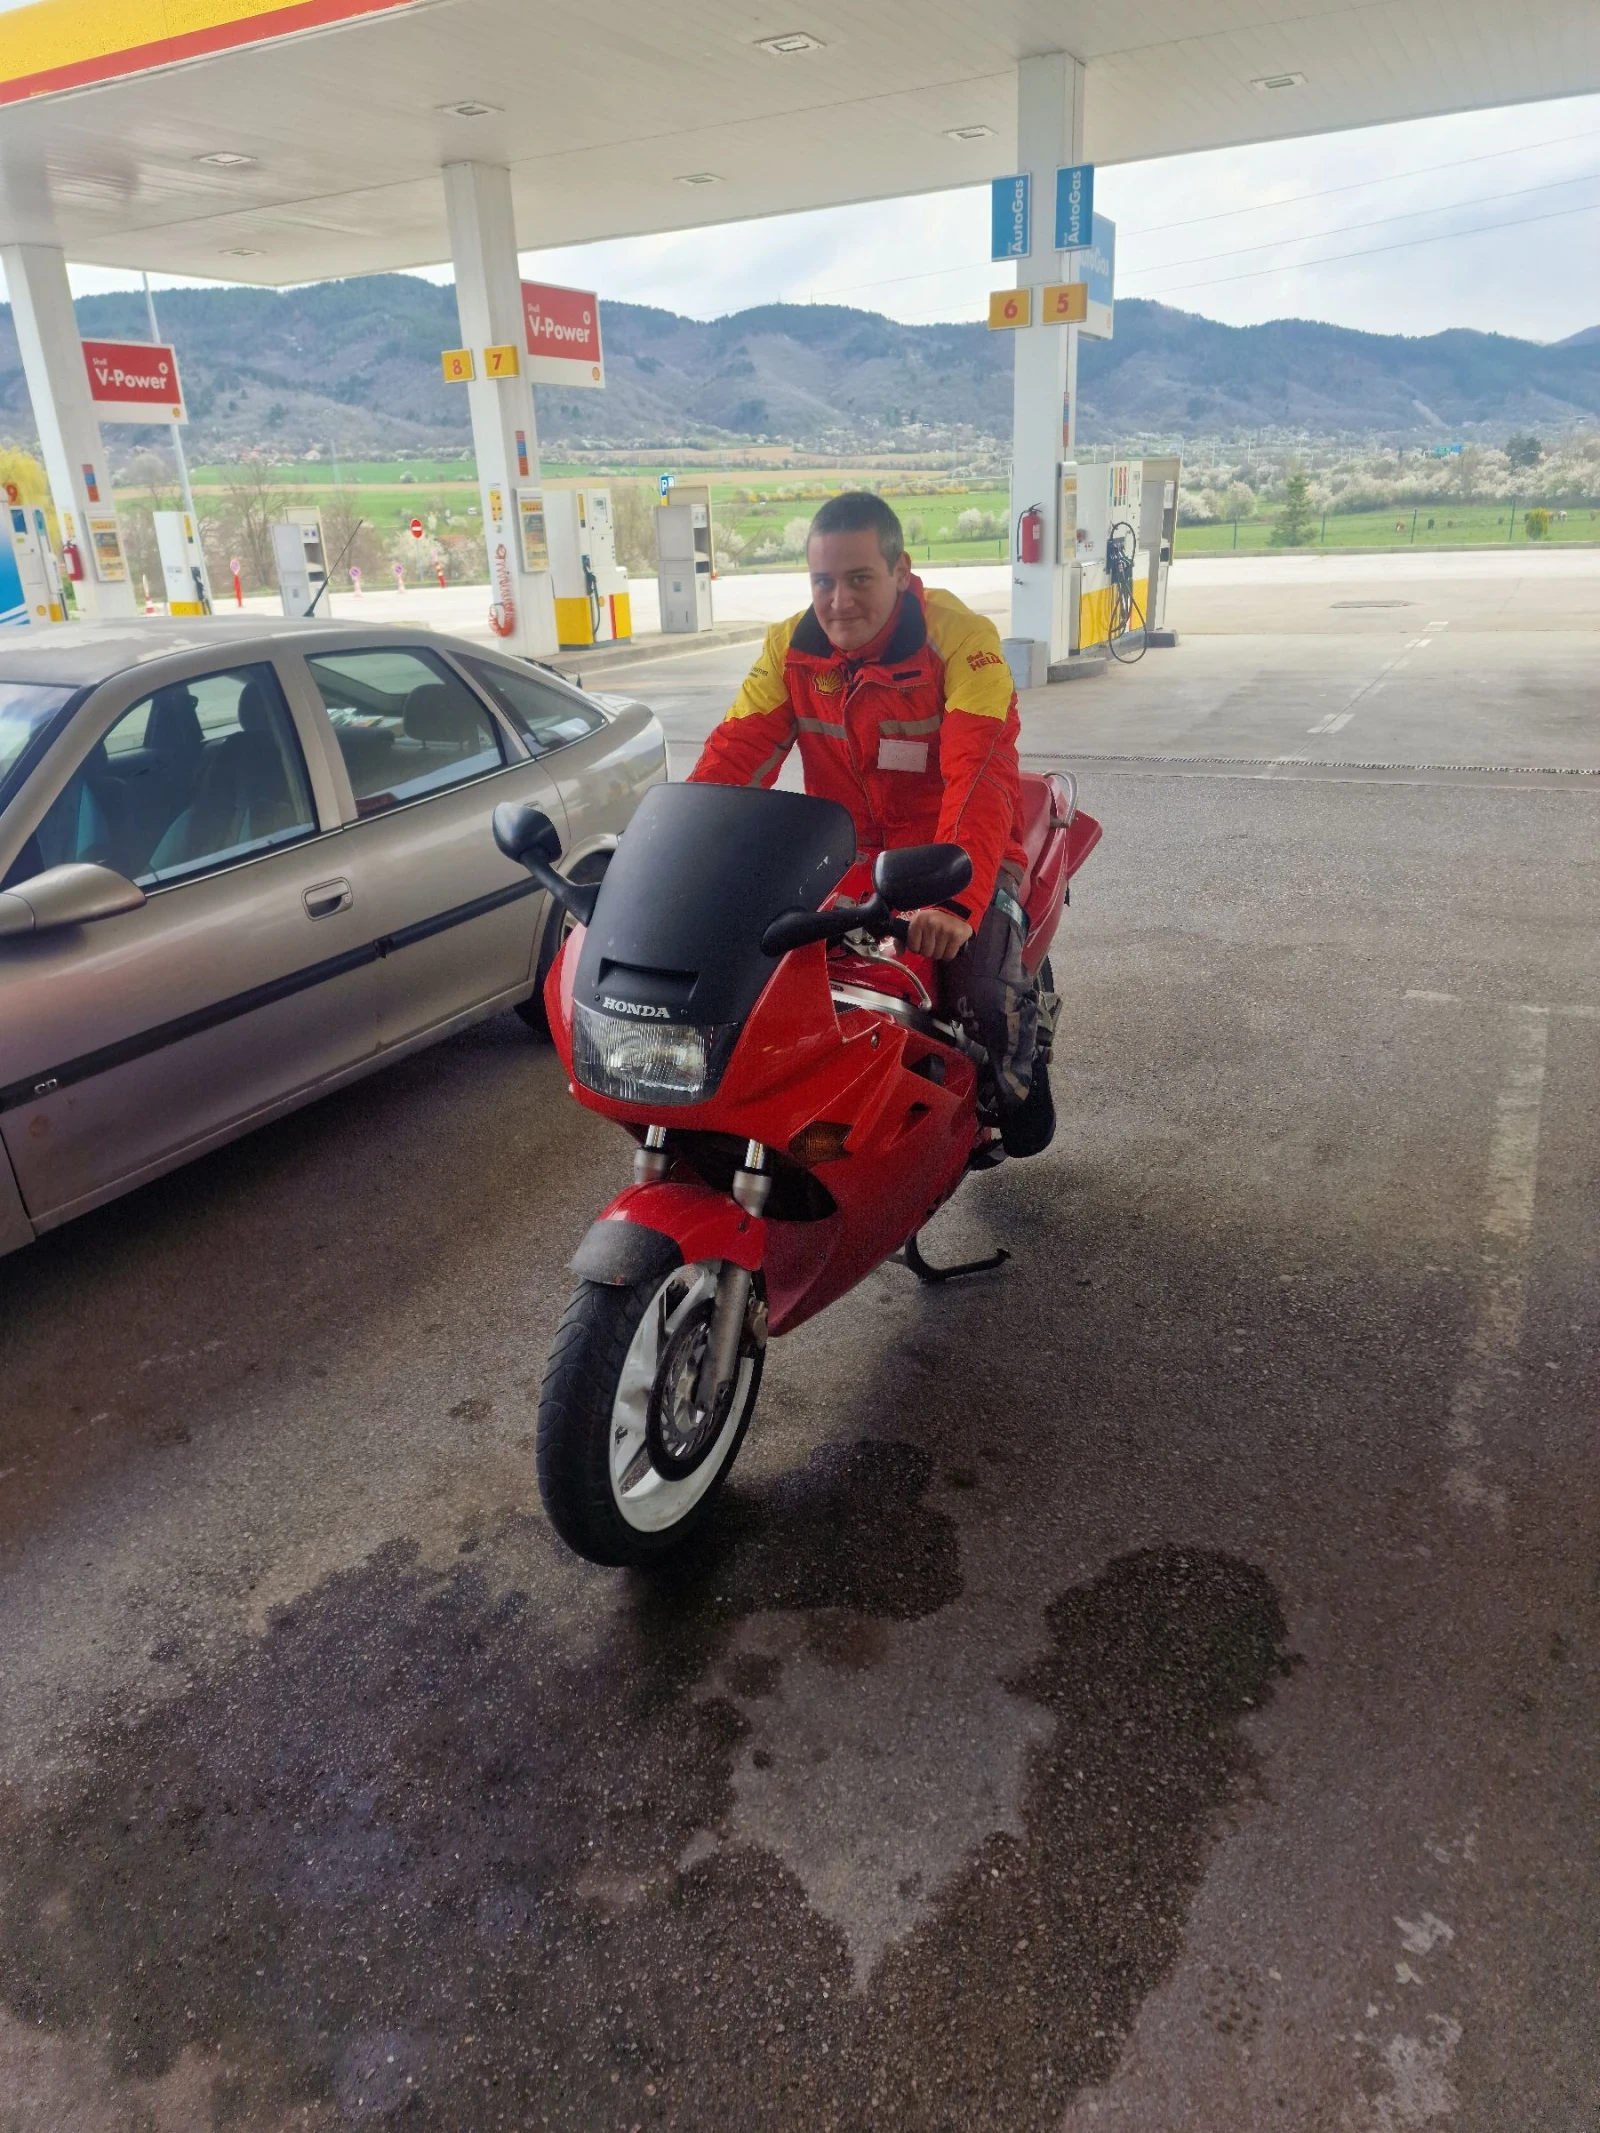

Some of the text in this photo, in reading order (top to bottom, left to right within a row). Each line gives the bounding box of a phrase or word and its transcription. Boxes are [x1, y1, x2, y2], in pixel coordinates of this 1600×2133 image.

[1011, 179, 1024, 254] AutoGas
[1068, 170, 1081, 244] AutoGas
[1004, 299, 1018, 319] 6
[1056, 293, 1069, 314] 5
[529, 315, 590, 343] V-Power
[452, 359, 463, 376] 8
[492, 353, 502, 371] 7
[95, 368, 167, 389] V-Power
[6, 484, 18, 502] 9
[661, 479, 668, 492] P
[602, 997, 671, 1019] HONDA
